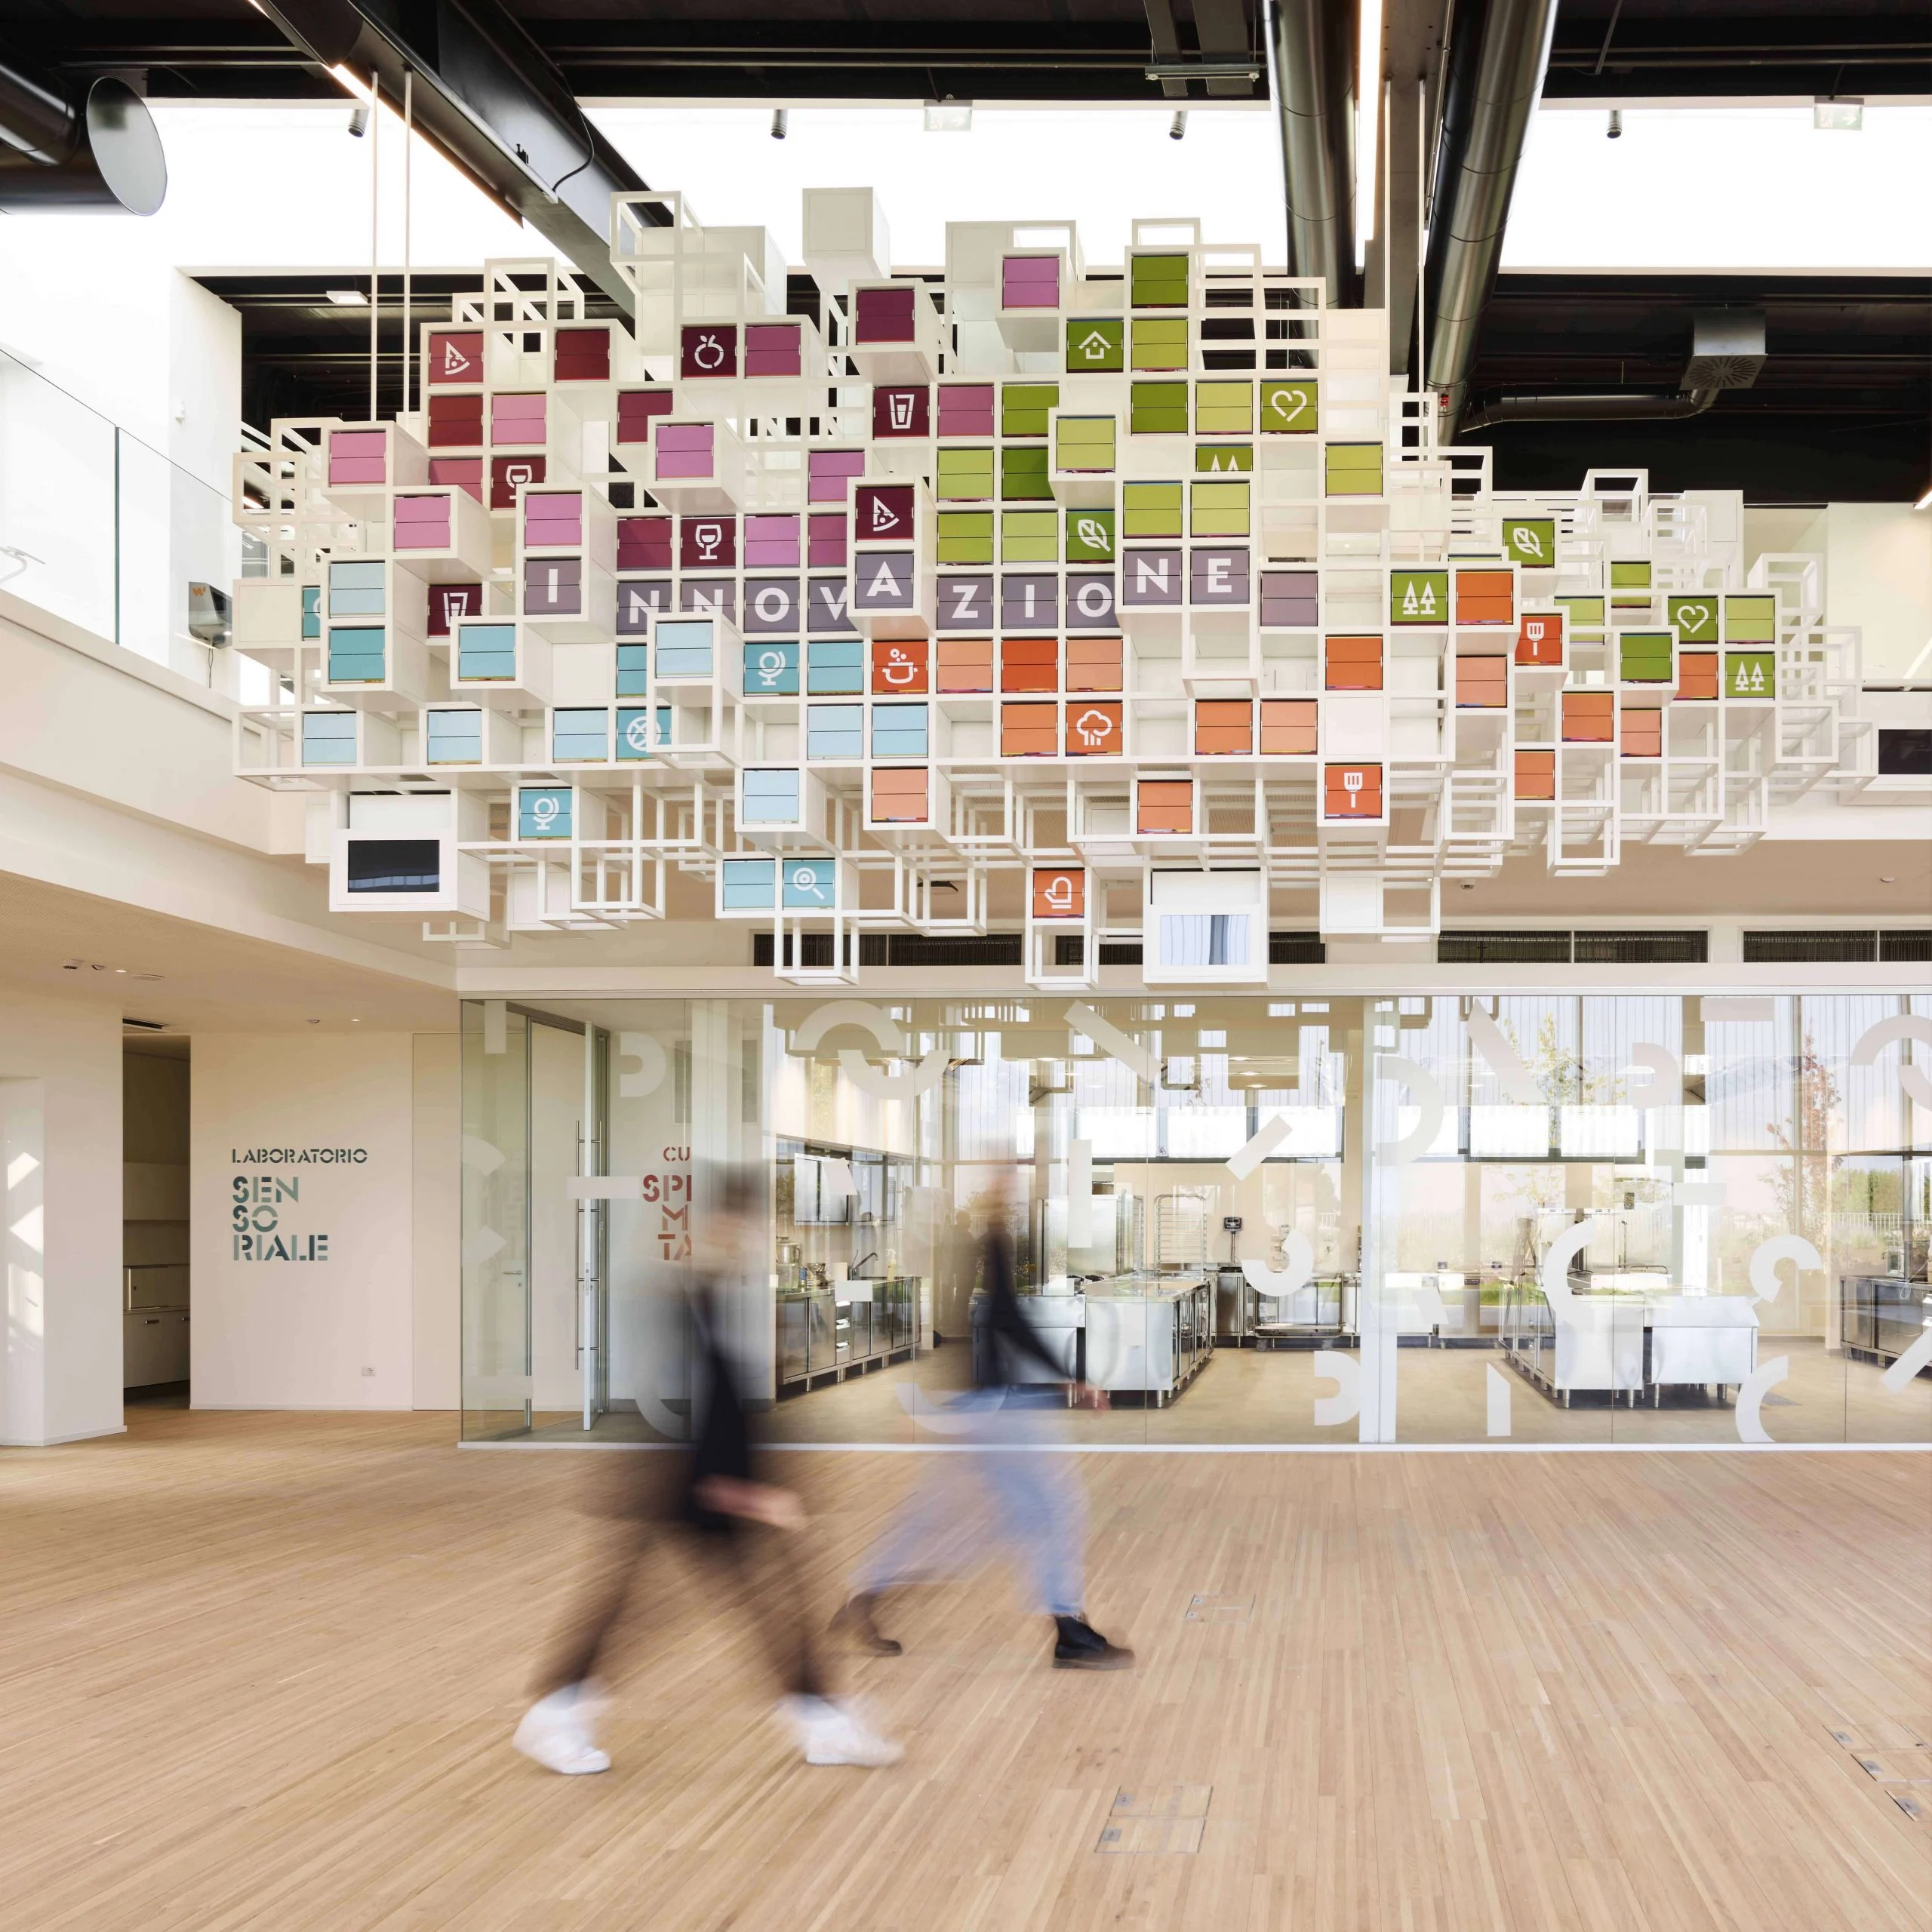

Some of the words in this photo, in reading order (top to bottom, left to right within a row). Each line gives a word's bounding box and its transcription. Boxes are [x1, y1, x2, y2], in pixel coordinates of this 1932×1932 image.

[548, 558, 1232, 624] INNOVAZIONE
[232, 1148, 368, 1163] LABORATORIO
[232, 1176, 299, 1204] SEN
[232, 1204, 278, 1232] SO
[233, 1234, 328, 1261] RIALE
